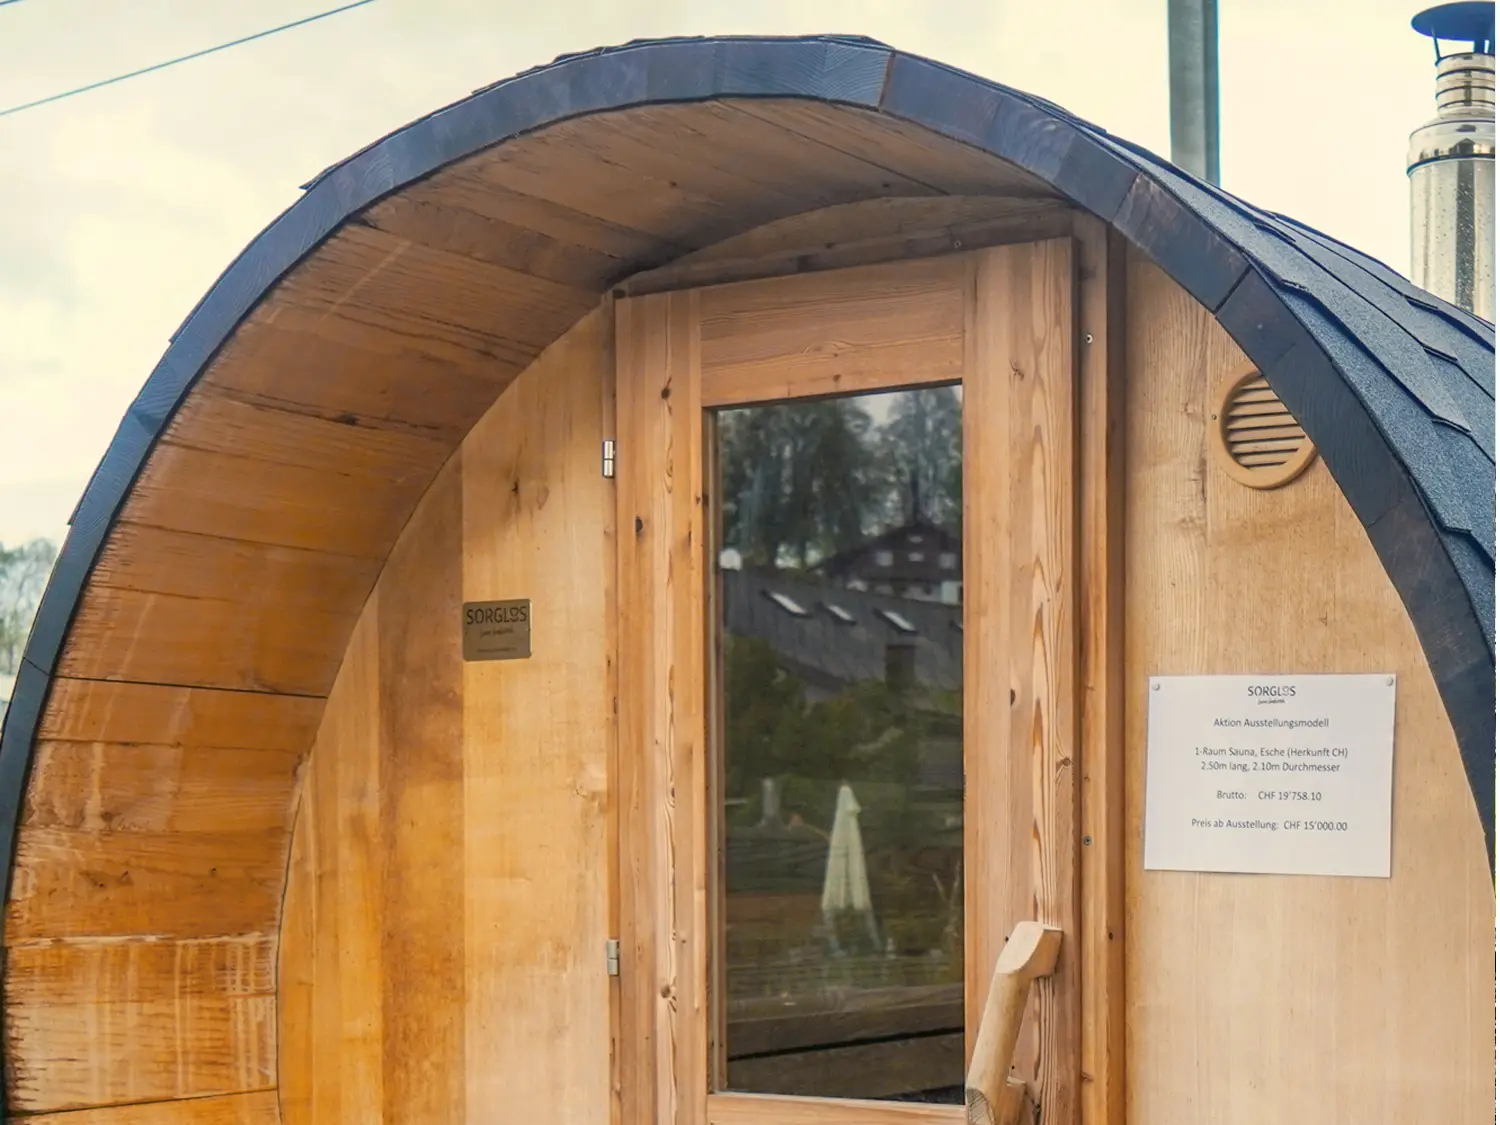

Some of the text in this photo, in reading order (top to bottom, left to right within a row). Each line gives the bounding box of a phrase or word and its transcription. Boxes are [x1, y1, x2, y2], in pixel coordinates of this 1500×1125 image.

[467, 606, 527, 625] SORGLOS
[1247, 685, 1296, 697] SORGLOS
[1213, 718, 1329, 730] Aktion Ausstellungsmodell
[1195, 747, 1348, 758] 1-Raum Sauna, Esche (Herkunft CH)
[1201, 761, 1340, 773] 2.50m lang, 2.10m Durchmesser
[1216, 790, 1247, 800] Brutto:
[1257, 791, 1276, 800] CHF
[1191, 818, 1212, 828] Preis
[1213, 819, 1224, 829] ab
[1226, 820, 1279, 831] Ausstellung:
[1283, 820, 1301, 830] CHF
